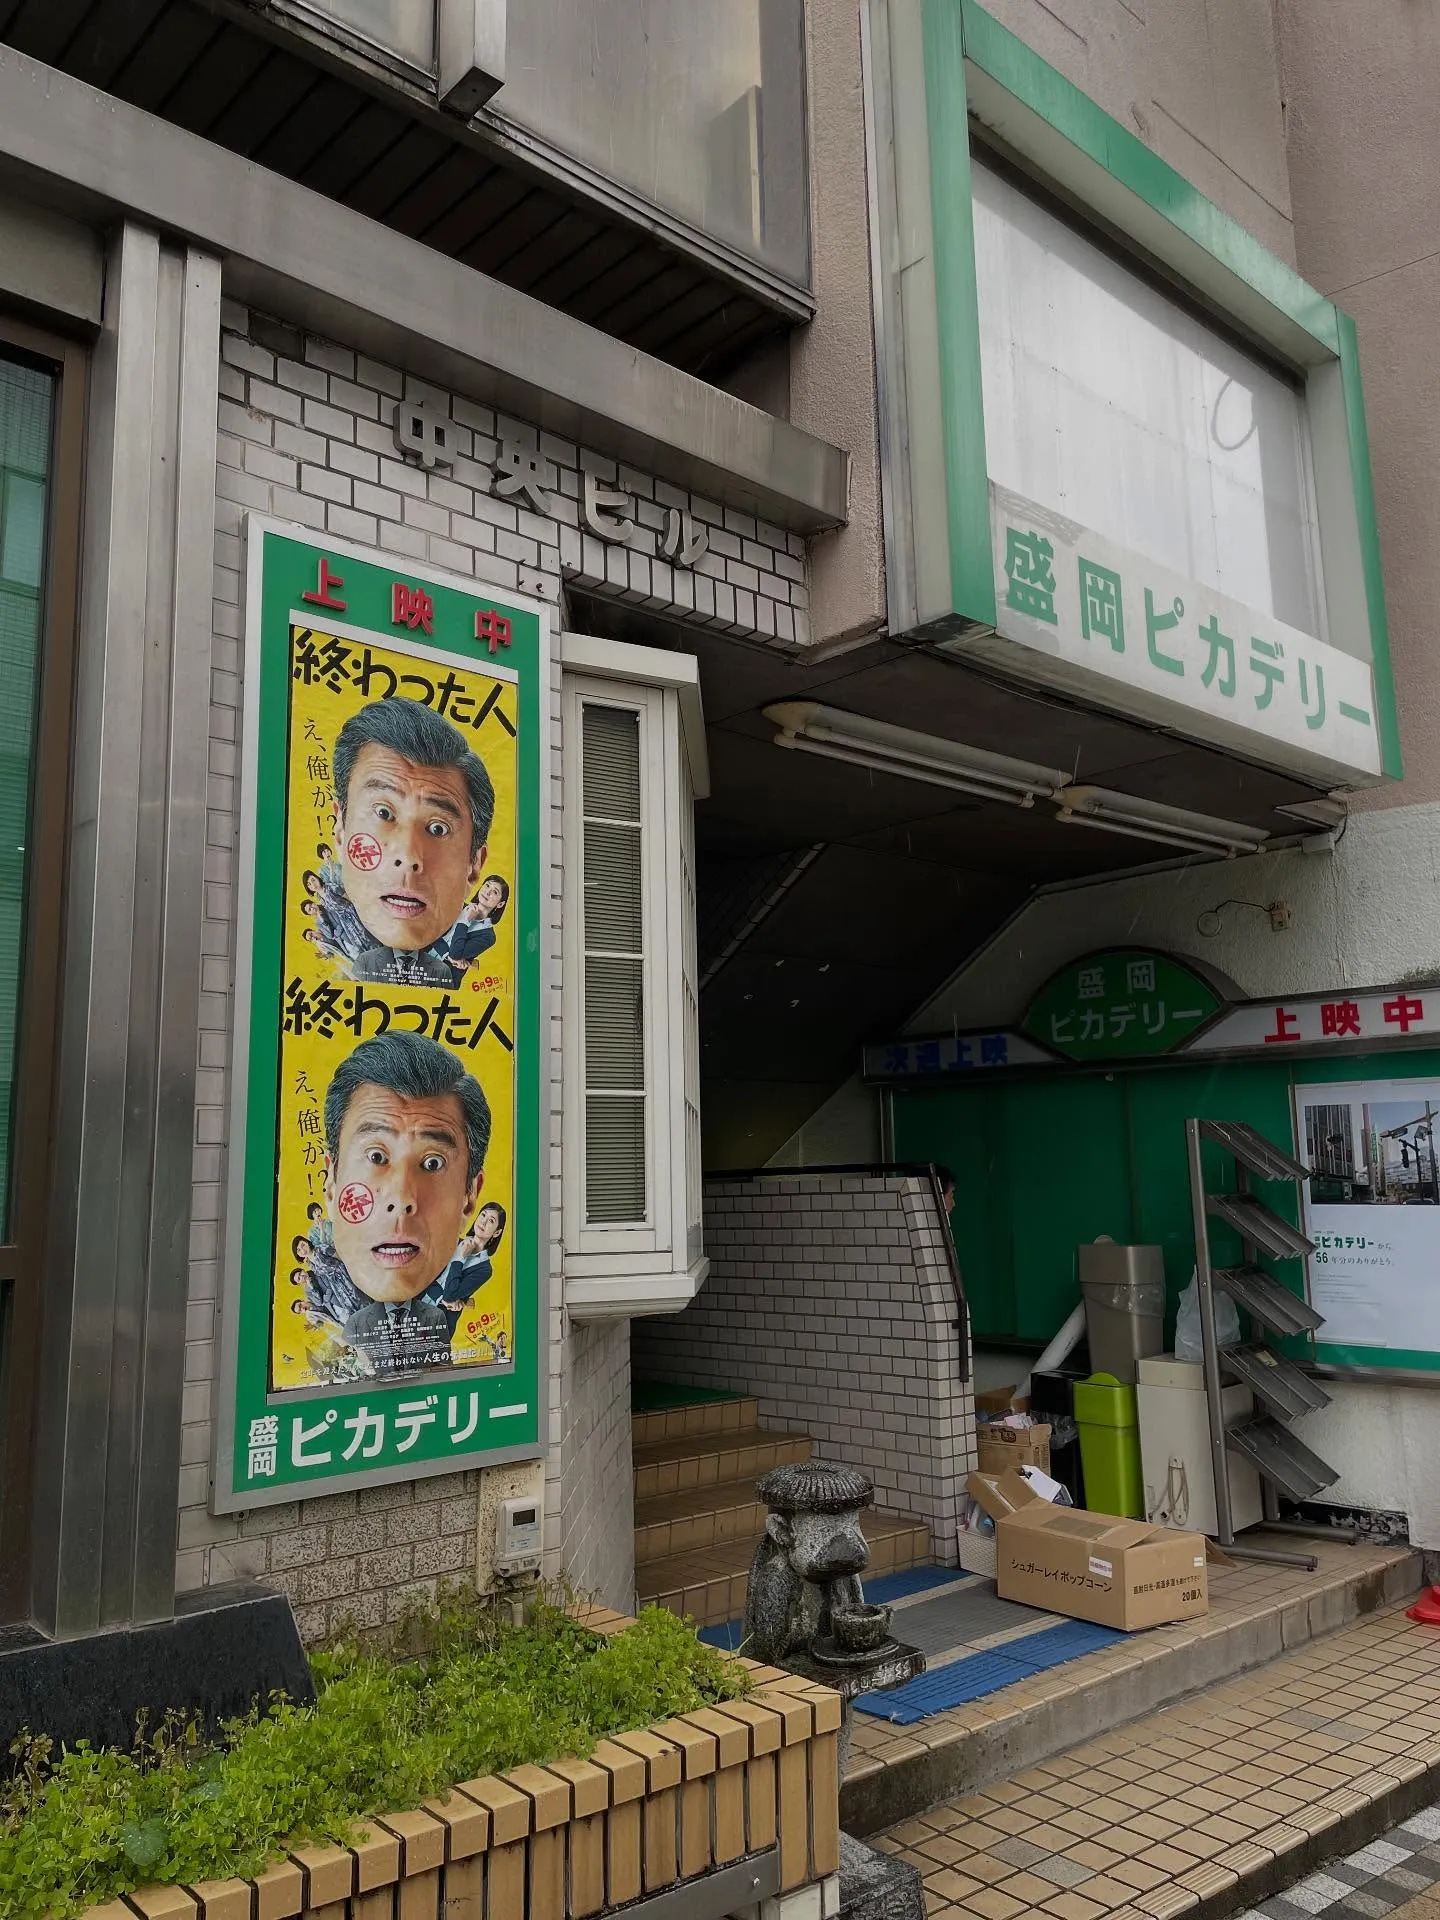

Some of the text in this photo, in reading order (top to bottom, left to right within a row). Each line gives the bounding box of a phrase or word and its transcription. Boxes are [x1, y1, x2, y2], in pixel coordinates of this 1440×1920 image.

[392, 399, 710, 569] 中央ビル
[302, 557, 513, 656] 上映中
[1004, 525, 1371, 731] 盛岡ピカデリー
[292, 628, 518, 738] 終わった人
[283, 976, 514, 1051] 終わった人
[1051, 1000, 1203, 1043] ピカデリー
[1078, 959, 1156, 999] 盛岡
[1264, 993, 1424, 1043] 上映中
[247, 1391, 529, 1480] 盛岡 ピカデリー
